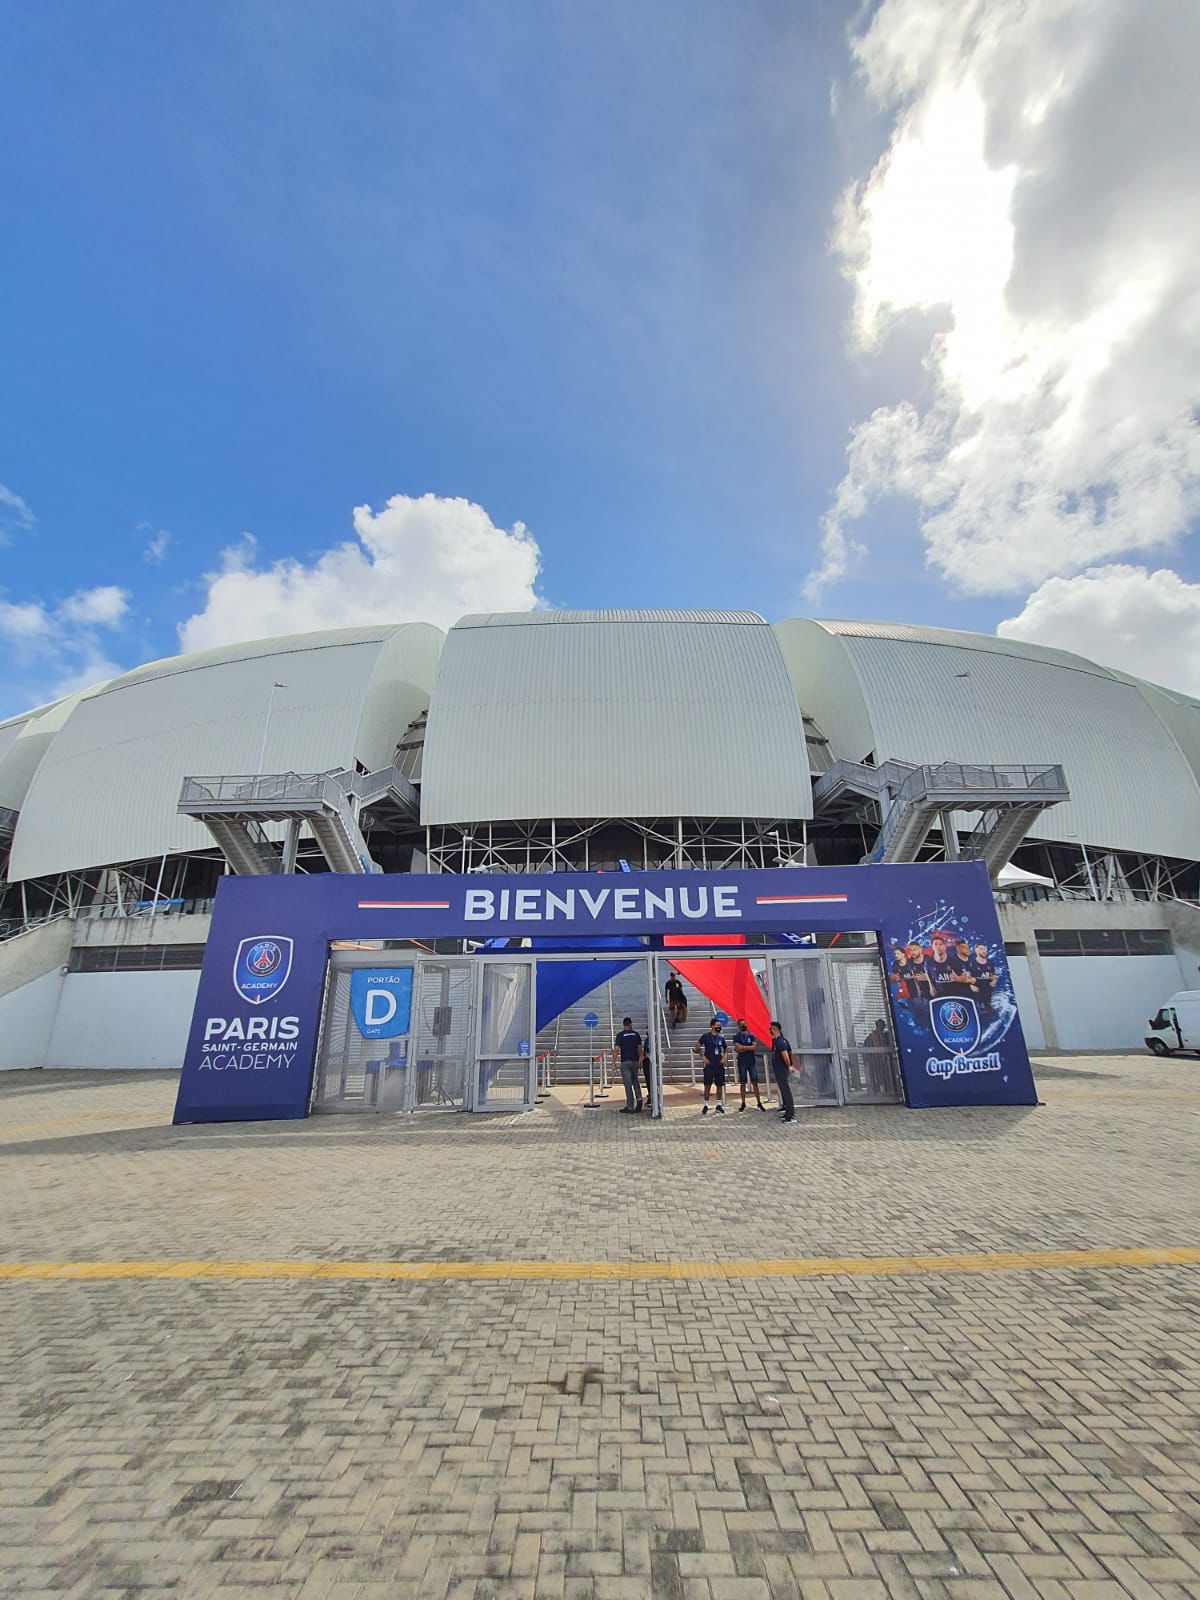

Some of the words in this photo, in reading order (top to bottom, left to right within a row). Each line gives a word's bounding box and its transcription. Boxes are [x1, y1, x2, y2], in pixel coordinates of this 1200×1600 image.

[464, 886, 742, 920] BIENVENUE
[254, 943, 277, 951] PARIS
[367, 975, 400, 984] PORTÃO
[365, 989, 397, 1025] D
[204, 1016, 300, 1040] PARIS
[202, 1041, 298, 1052] SAINT-GERMAIN
[198, 1053, 296, 1071] ACADEMY
[927, 1058, 954, 1079] Cup
[954, 1053, 1000, 1073] Brasil
